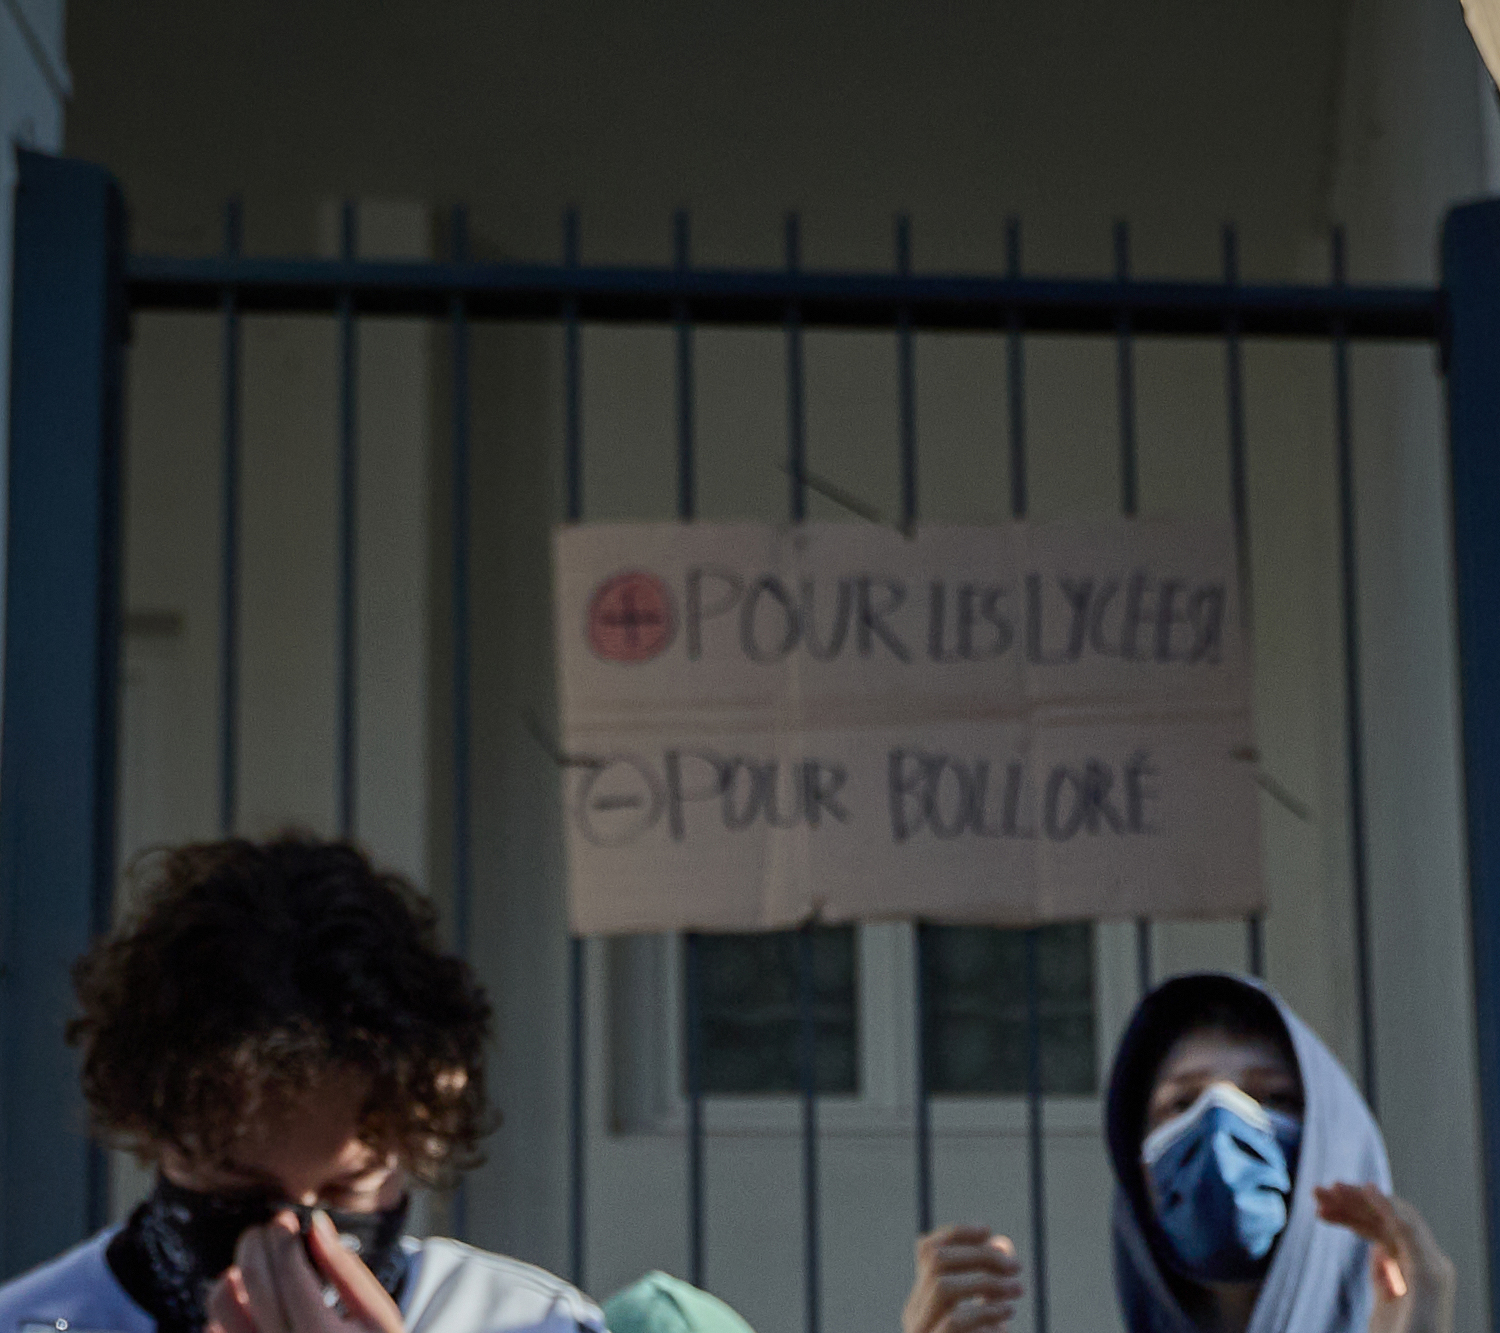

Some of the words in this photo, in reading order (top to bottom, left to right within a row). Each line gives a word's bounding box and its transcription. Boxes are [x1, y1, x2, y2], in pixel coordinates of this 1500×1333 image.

[686, 566, 913, 664] POUR
[928, 576, 1015, 664] LES
[666, 746, 851, 842] POUR
